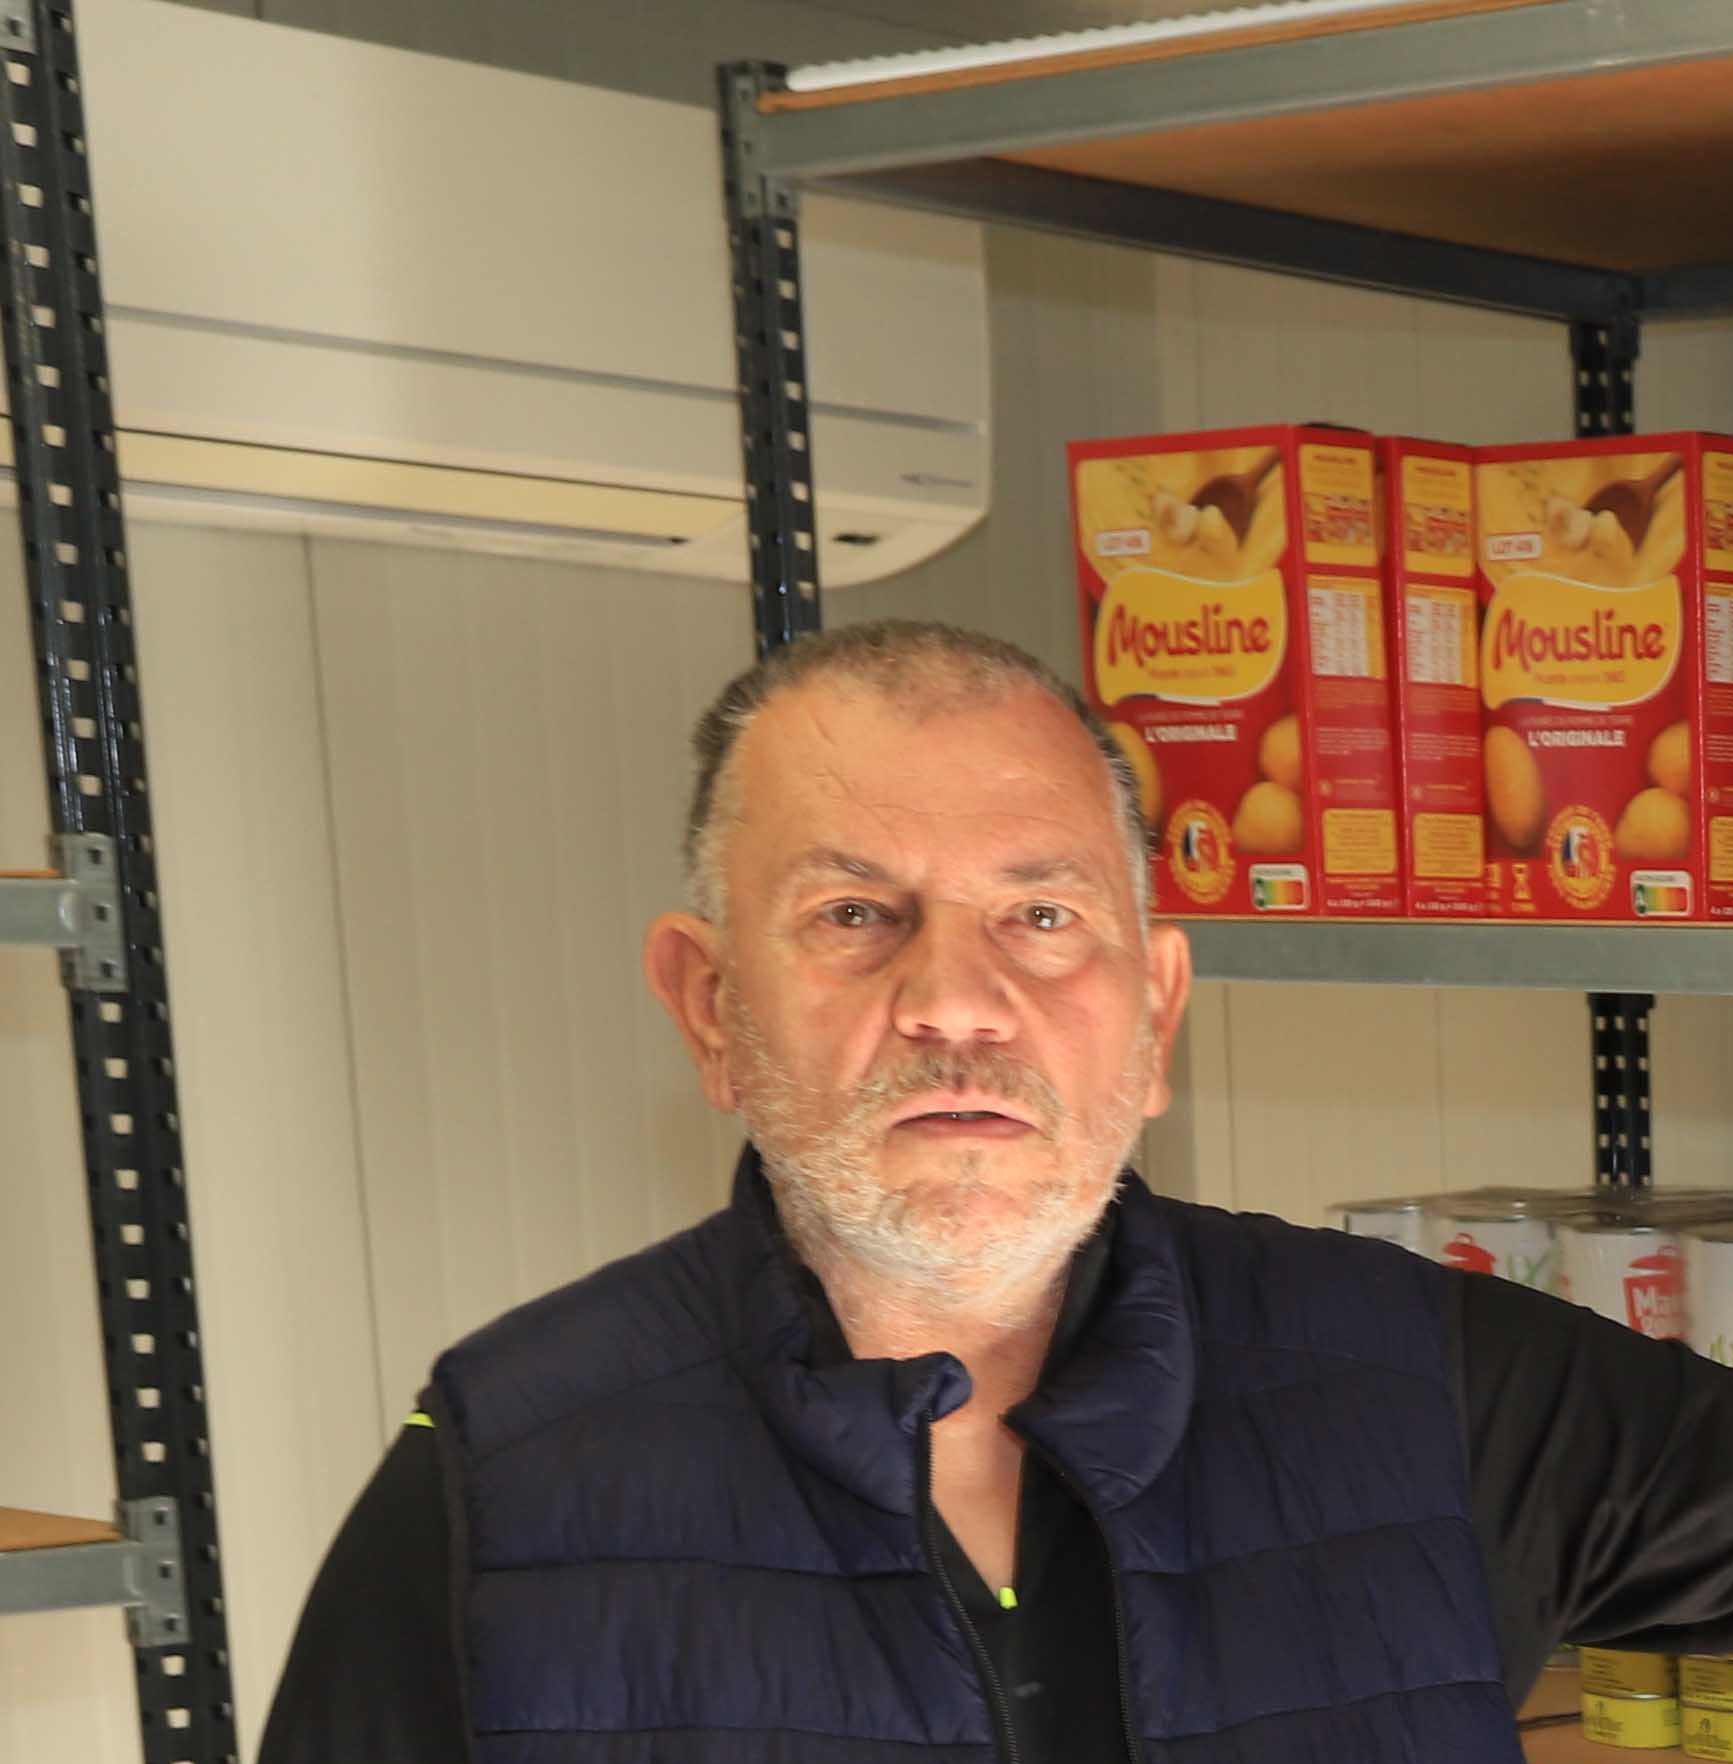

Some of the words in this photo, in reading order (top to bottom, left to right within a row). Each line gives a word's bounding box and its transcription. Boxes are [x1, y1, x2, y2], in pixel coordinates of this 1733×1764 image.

[1108, 603, 1271, 668] Mousline
[1492, 608, 1665, 672] Mousline
[1528, 730, 1625, 747] L'ORIGINALE
